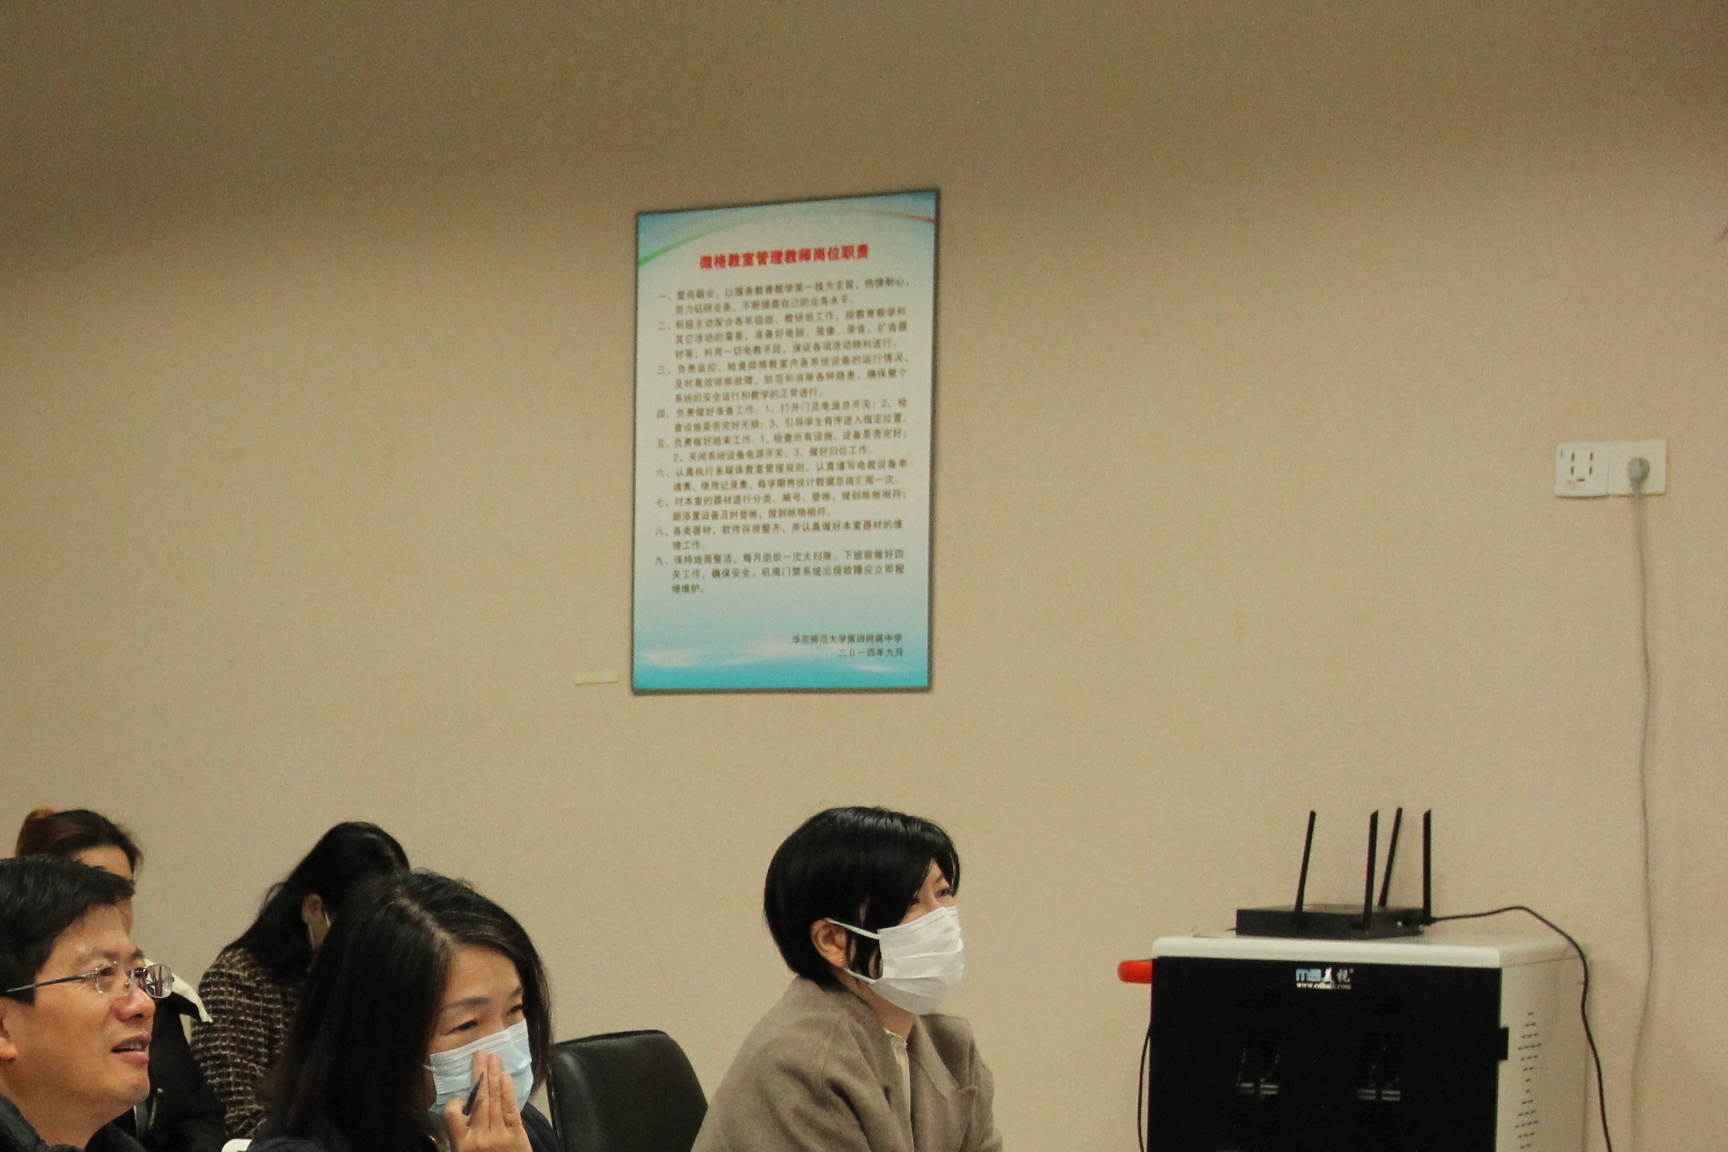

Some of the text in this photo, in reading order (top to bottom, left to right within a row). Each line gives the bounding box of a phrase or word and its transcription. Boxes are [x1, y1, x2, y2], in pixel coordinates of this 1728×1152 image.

[699, 243, 868, 269] 微格教室管理教师岗位职责
